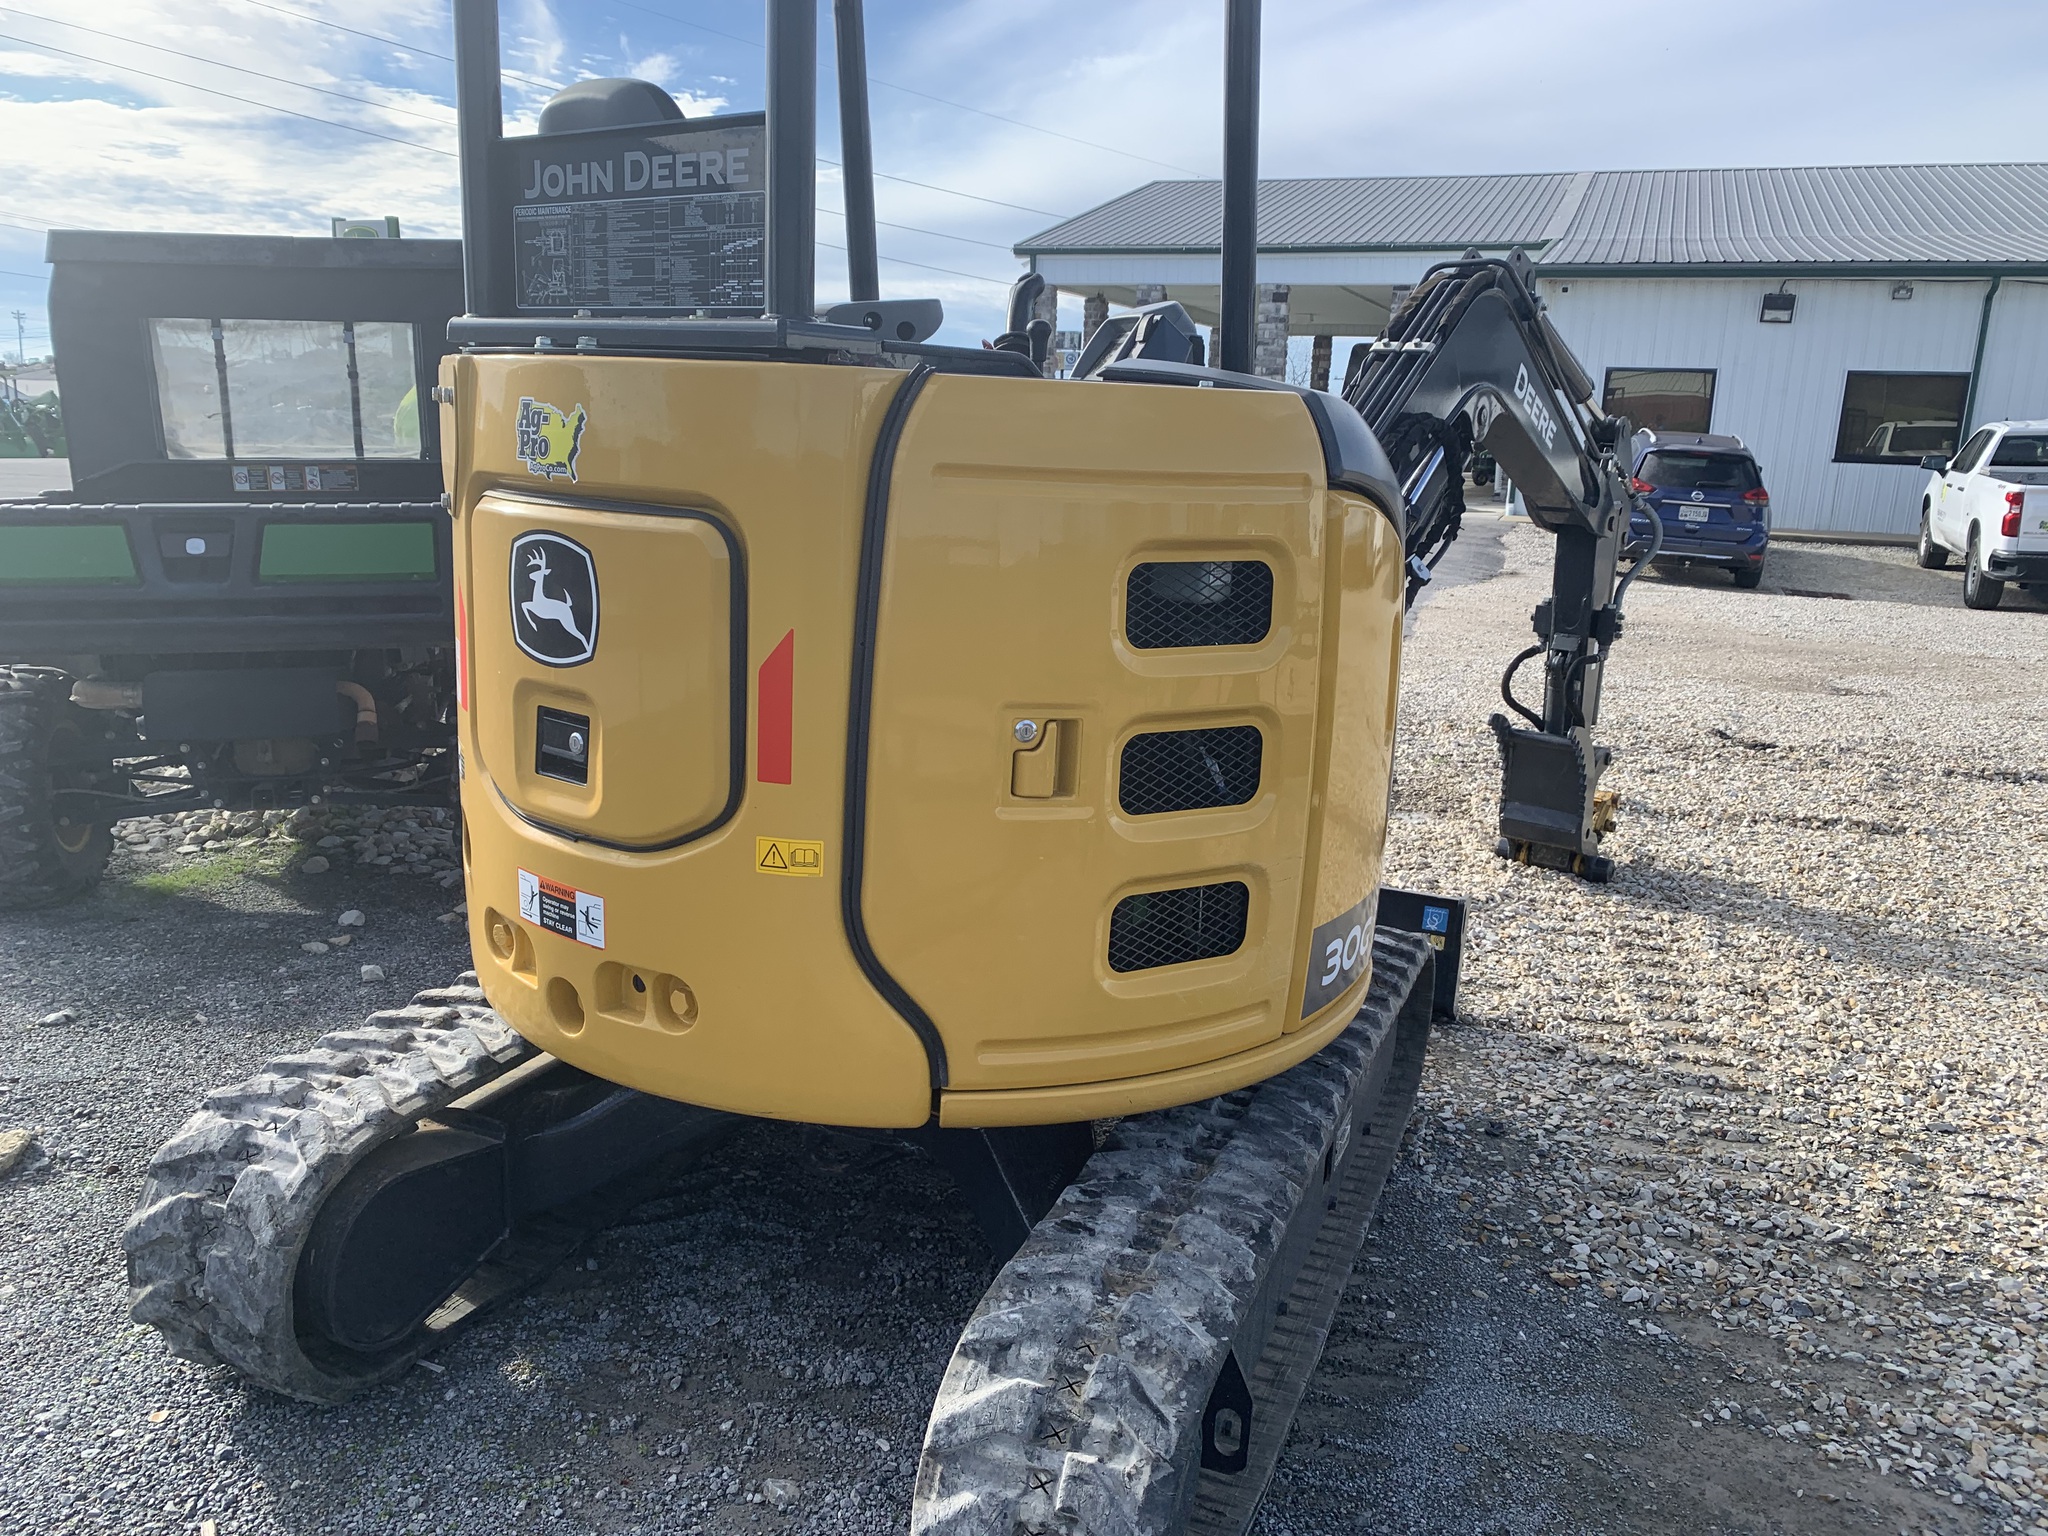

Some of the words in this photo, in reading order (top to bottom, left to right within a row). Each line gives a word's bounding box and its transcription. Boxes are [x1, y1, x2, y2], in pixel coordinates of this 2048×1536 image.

[524, 159, 614, 200] JOHN
[623, 147, 750, 192] DEERE
[515, 208, 537, 217] PERIODIC
[537, 205, 572, 215] MAINTENANCE
[1513, 362, 1557, 450] DEERE
[517, 429, 550, 460] Pro
[545, 883, 574, 899] WARNING
[542, 896, 559, 906] Operator
[560, 903, 569, 911] may
[542, 910, 559, 919] machine
[560, 910, 575, 919] reverse
[543, 917, 555, 927] STAY
[555, 922, 573, 934] CLEAR
